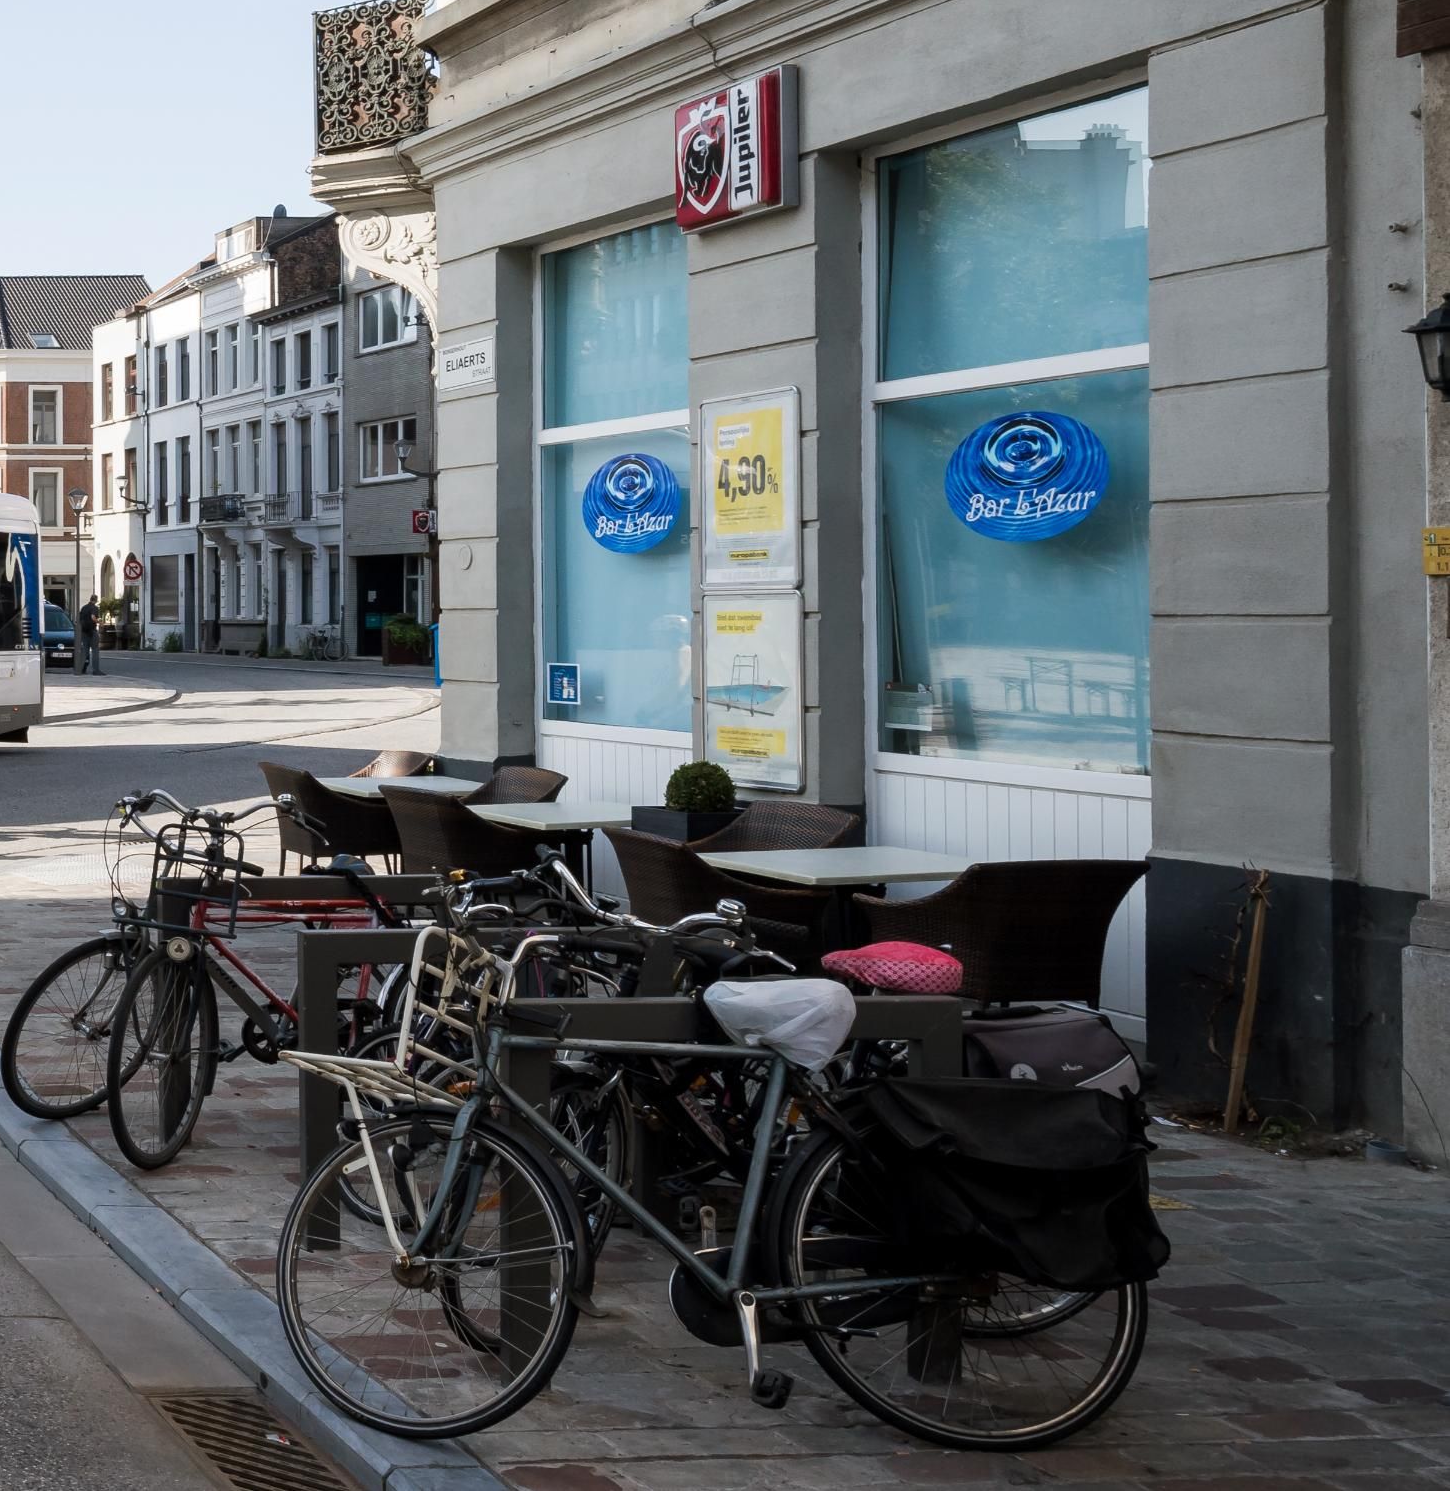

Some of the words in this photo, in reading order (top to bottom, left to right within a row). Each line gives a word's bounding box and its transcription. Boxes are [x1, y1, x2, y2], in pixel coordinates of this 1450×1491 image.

[734, 88, 756, 201] Jupiler
[446, 352, 486, 372] ELIAERTS
[965, 493, 1010, 522] Bar
[1013, 487, 1097, 519] L'Azur
[595, 515, 622, 538] Bar
[624, 512, 673, 536] L'Azur
